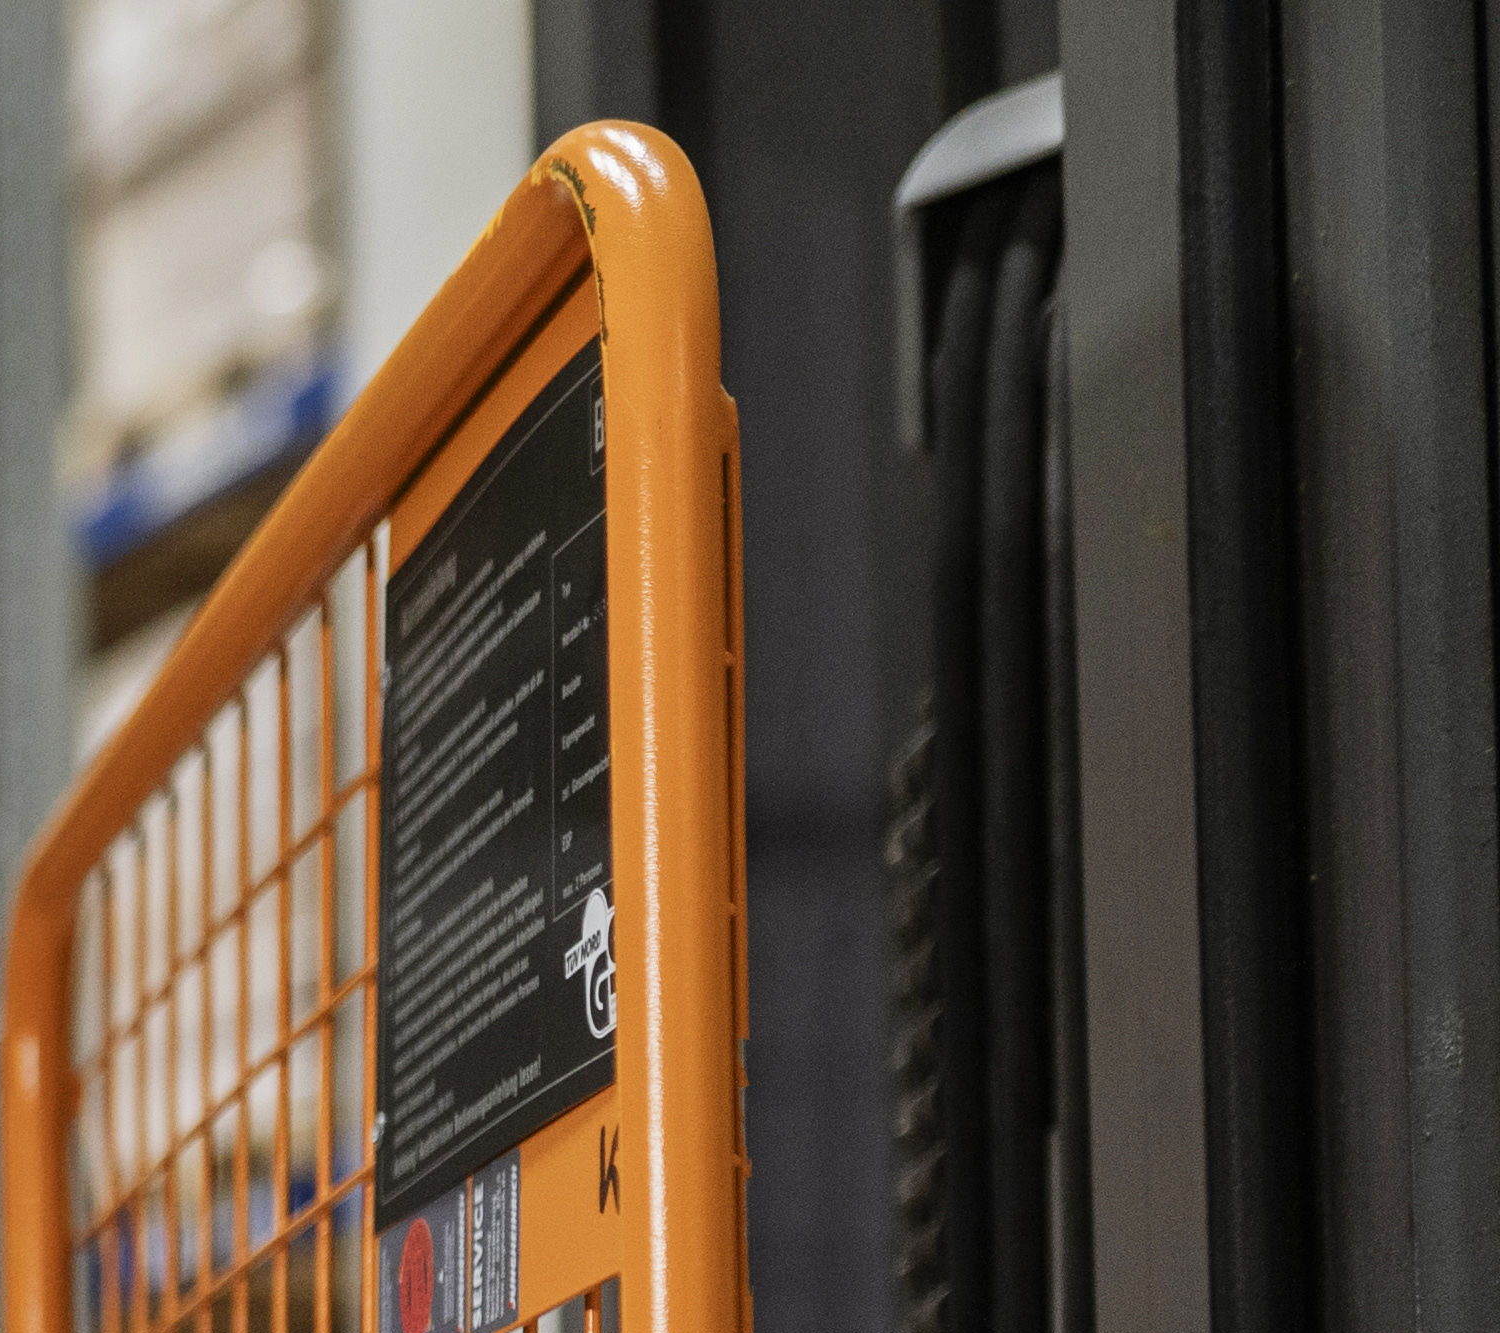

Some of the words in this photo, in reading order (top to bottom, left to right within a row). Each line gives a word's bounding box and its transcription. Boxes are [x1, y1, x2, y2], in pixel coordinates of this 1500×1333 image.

[580, 929, 602, 960] NORD
[519, 1053, 541, 1088] lesen!
[472, 1182, 484, 1330] SERVICE
[509, 1164, 518, 1310] JUNGHEINRICH
